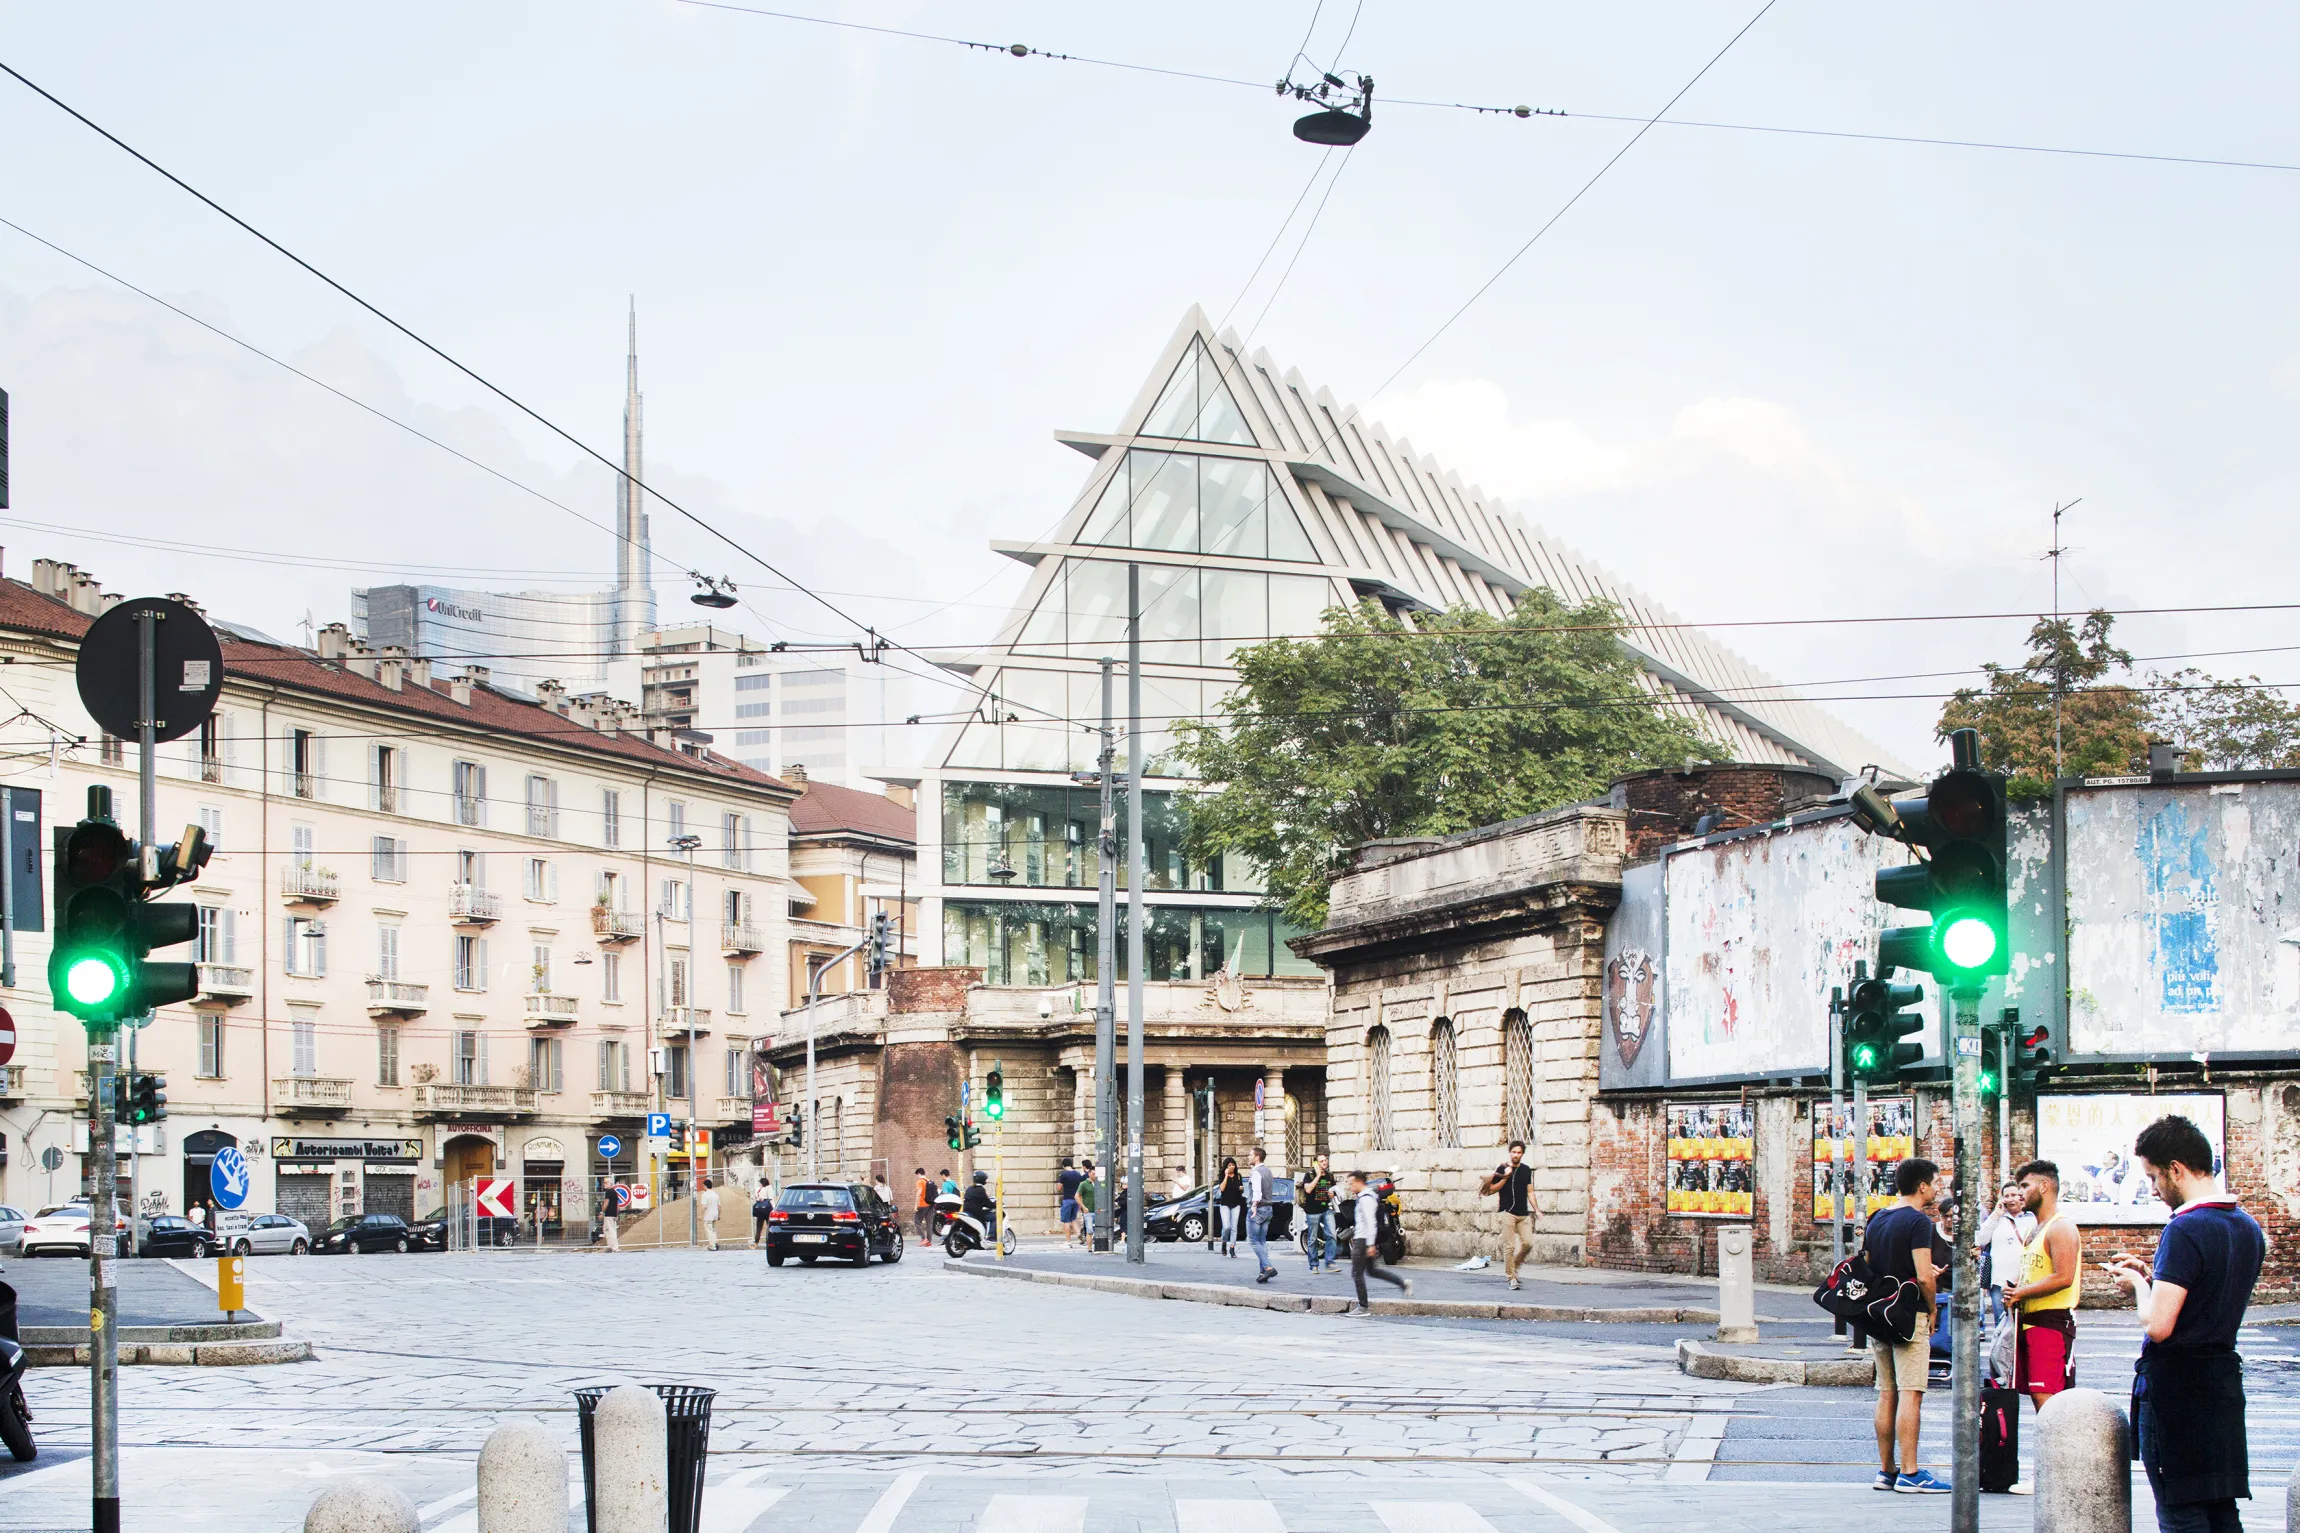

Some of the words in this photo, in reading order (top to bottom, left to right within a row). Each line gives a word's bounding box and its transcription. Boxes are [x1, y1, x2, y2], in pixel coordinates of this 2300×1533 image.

[437, 602, 482, 622] UniCredit
[2043, 1101, 2124, 1128] 蒙恩的人
[447, 1124, 492, 1133] AUTOFFICINA
[652, 1115, 666, 1134] P
[295, 1141, 363, 1156] Autoricambi
[363, 1142, 393, 1156] Volta
[375, 1165, 388, 1173] GTX
[633, 1188, 647, 1196] STOP
